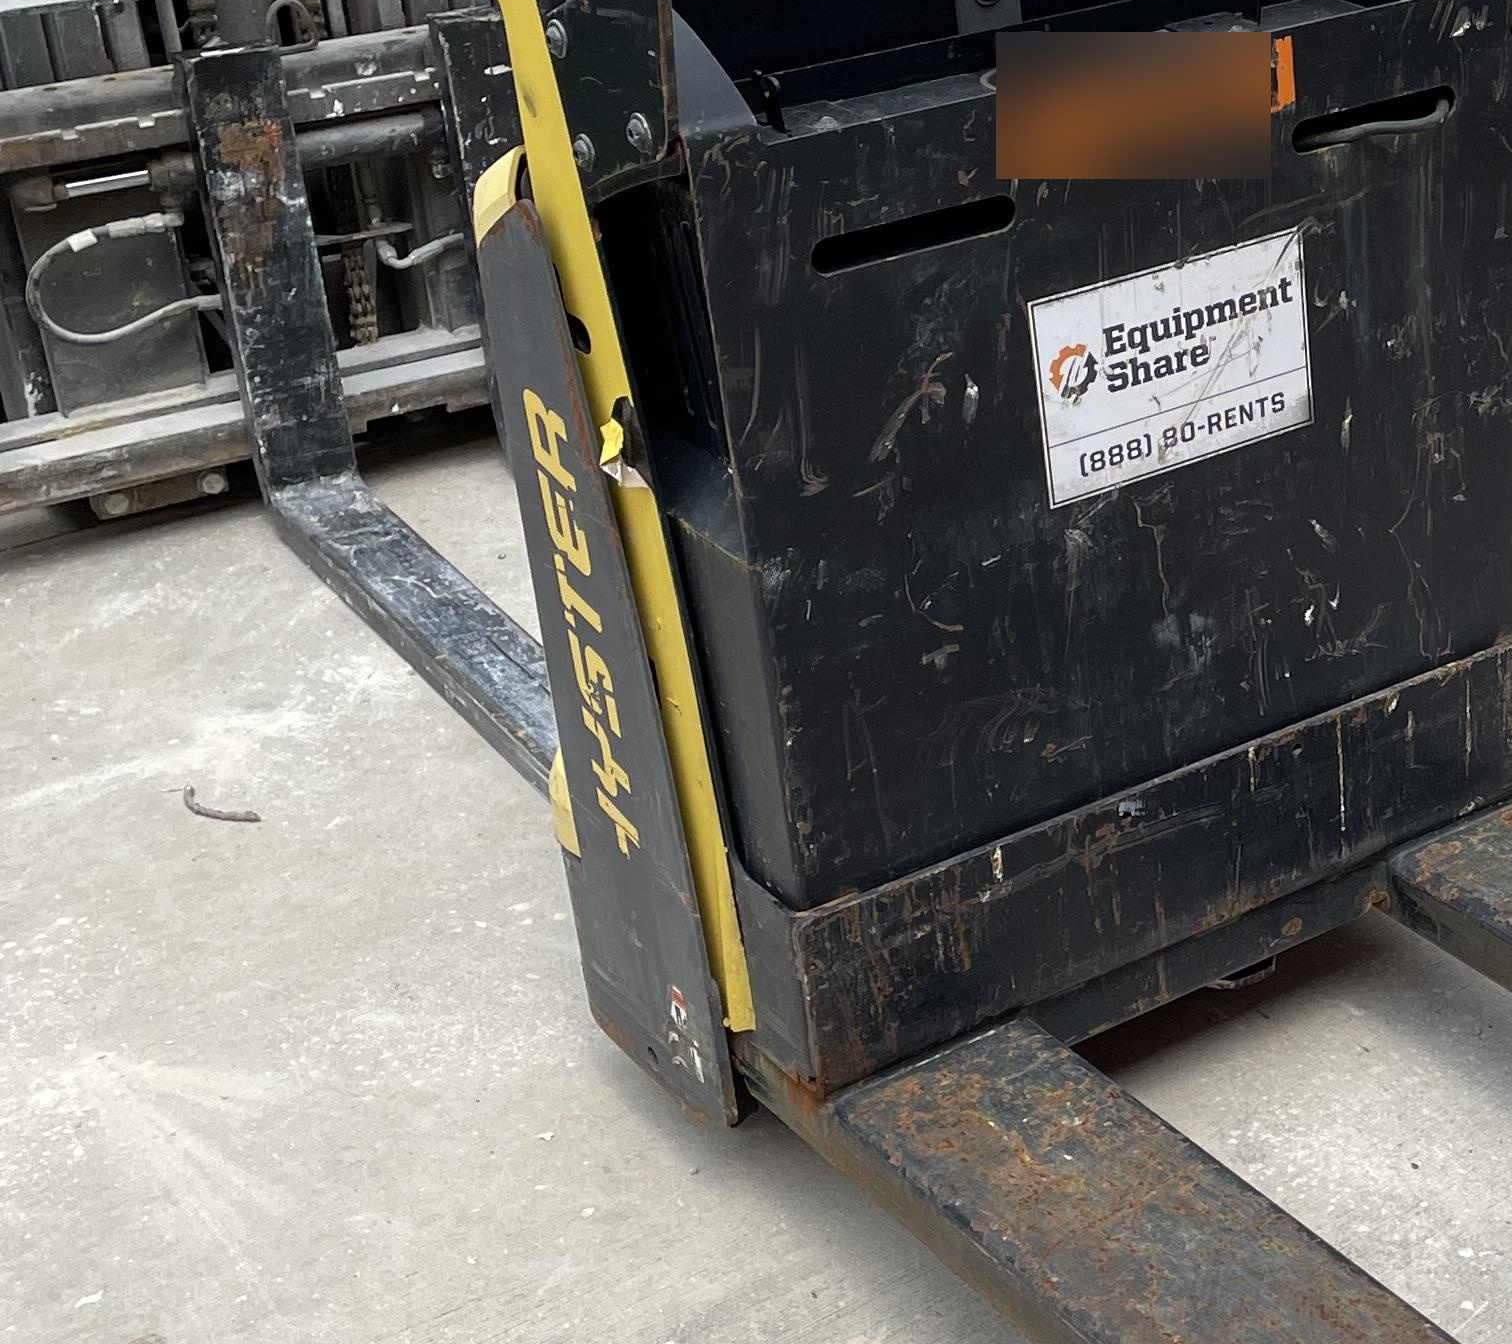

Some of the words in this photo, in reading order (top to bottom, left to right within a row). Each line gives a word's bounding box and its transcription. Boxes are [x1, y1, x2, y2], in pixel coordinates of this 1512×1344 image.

[1102, 276, 1294, 357] Equipment
[1105, 343, 1210, 394] Share
[1079, 432, 1153, 478] (888)
[1161, 391, 1286, 450] 80-RENTS
